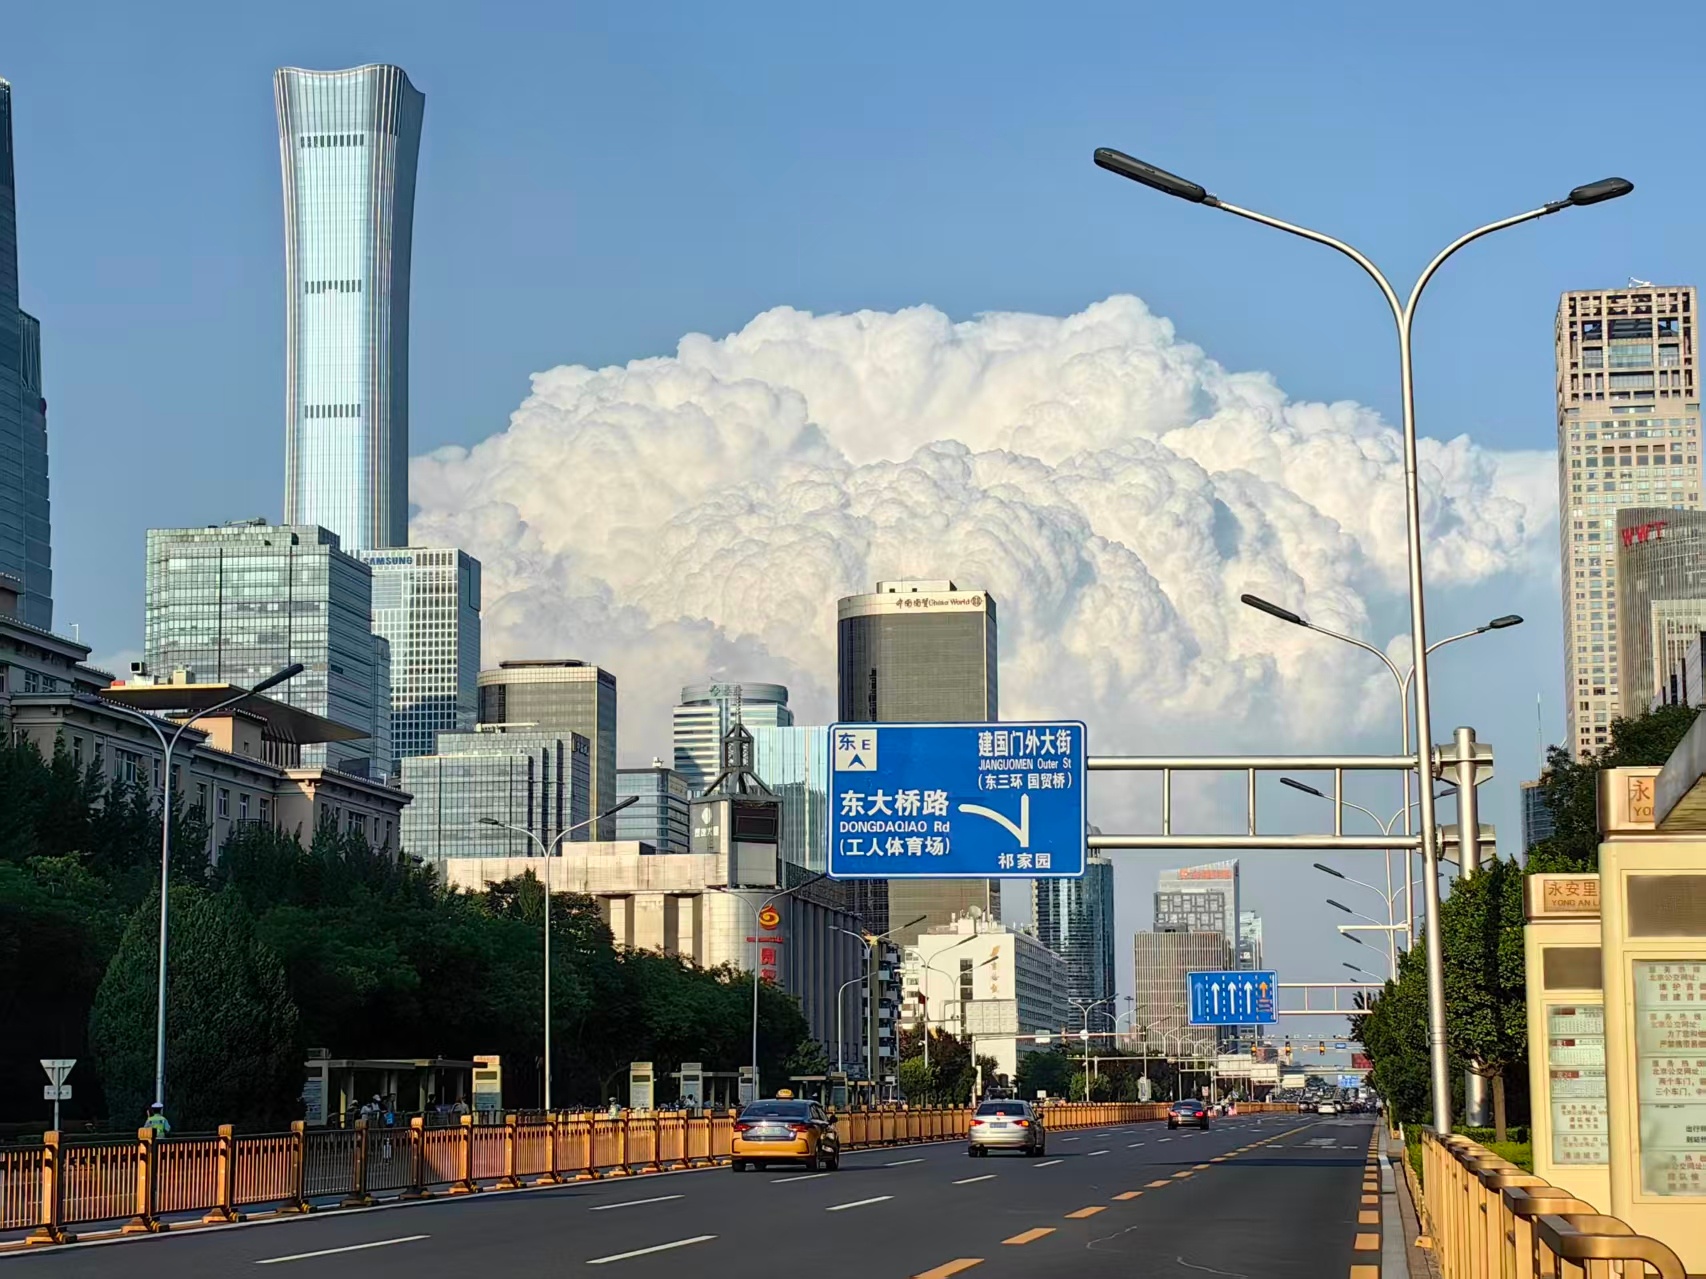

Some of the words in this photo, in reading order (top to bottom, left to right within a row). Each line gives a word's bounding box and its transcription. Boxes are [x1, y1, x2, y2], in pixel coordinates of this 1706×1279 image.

[363, 556, 413, 566] SAMSUNG
[838, 733, 856, 751] 东
[861, 740, 871, 750] E
[978, 729, 1071, 757] 建国门外大街
[978, 758, 1033, 771] JIANGUOMEN
[1037, 758, 1058, 769] Outer
[1063, 757, 1072, 769] St
[978, 773, 1023, 790] (东三环
[1027, 772, 1072, 789] 国贸桥)
[1629, 780, 1651, 801] 永
[840, 789, 949, 817] 东大桥路
[840, 821, 927, 833] DONGDAQIAO
[934, 821, 950, 833] Rd
[839, 837, 950, 857] (工人体育场)
[998, 853, 1051, 869] 祁家园
[1548, 881, 1598, 897] 永安里
